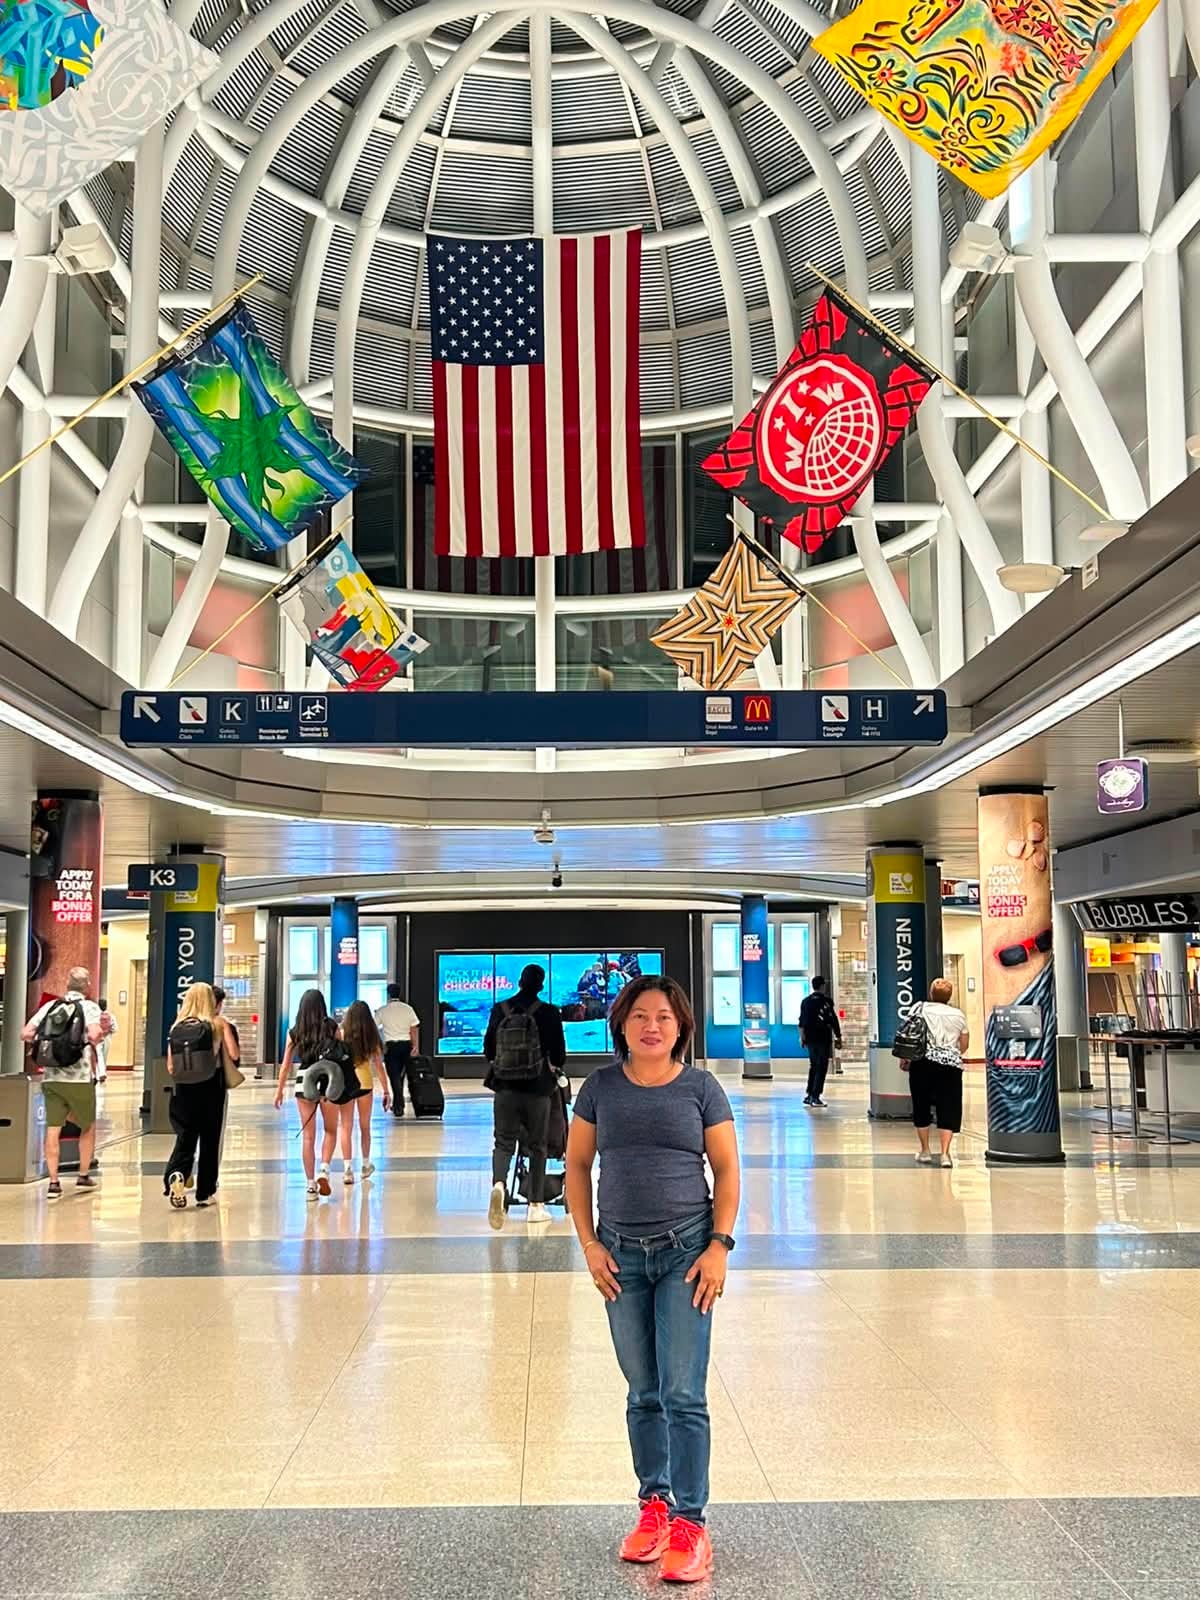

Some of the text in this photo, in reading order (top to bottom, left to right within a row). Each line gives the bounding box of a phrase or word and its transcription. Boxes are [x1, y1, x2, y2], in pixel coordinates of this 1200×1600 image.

[225, 702, 242, 721] K
[866, 699, 882, 718] H
[60, 869, 94, 880] APPLY
[149, 869, 176, 886] K3
[988, 875, 1023, 885] TODAY
[55, 880, 93, 890] TODAY
[59, 890, 93, 900] FOR A
[52, 900, 93, 911] BONUS
[989, 896, 1026, 906] BONUS
[56, 911, 92, 922] OFFER
[989, 906, 1022, 916] OFFER
[1090, 901, 1189, 928] BUBBLES
[178, 927, 195, 970] YOU
[895, 918, 913, 1022] NEAR YOU
